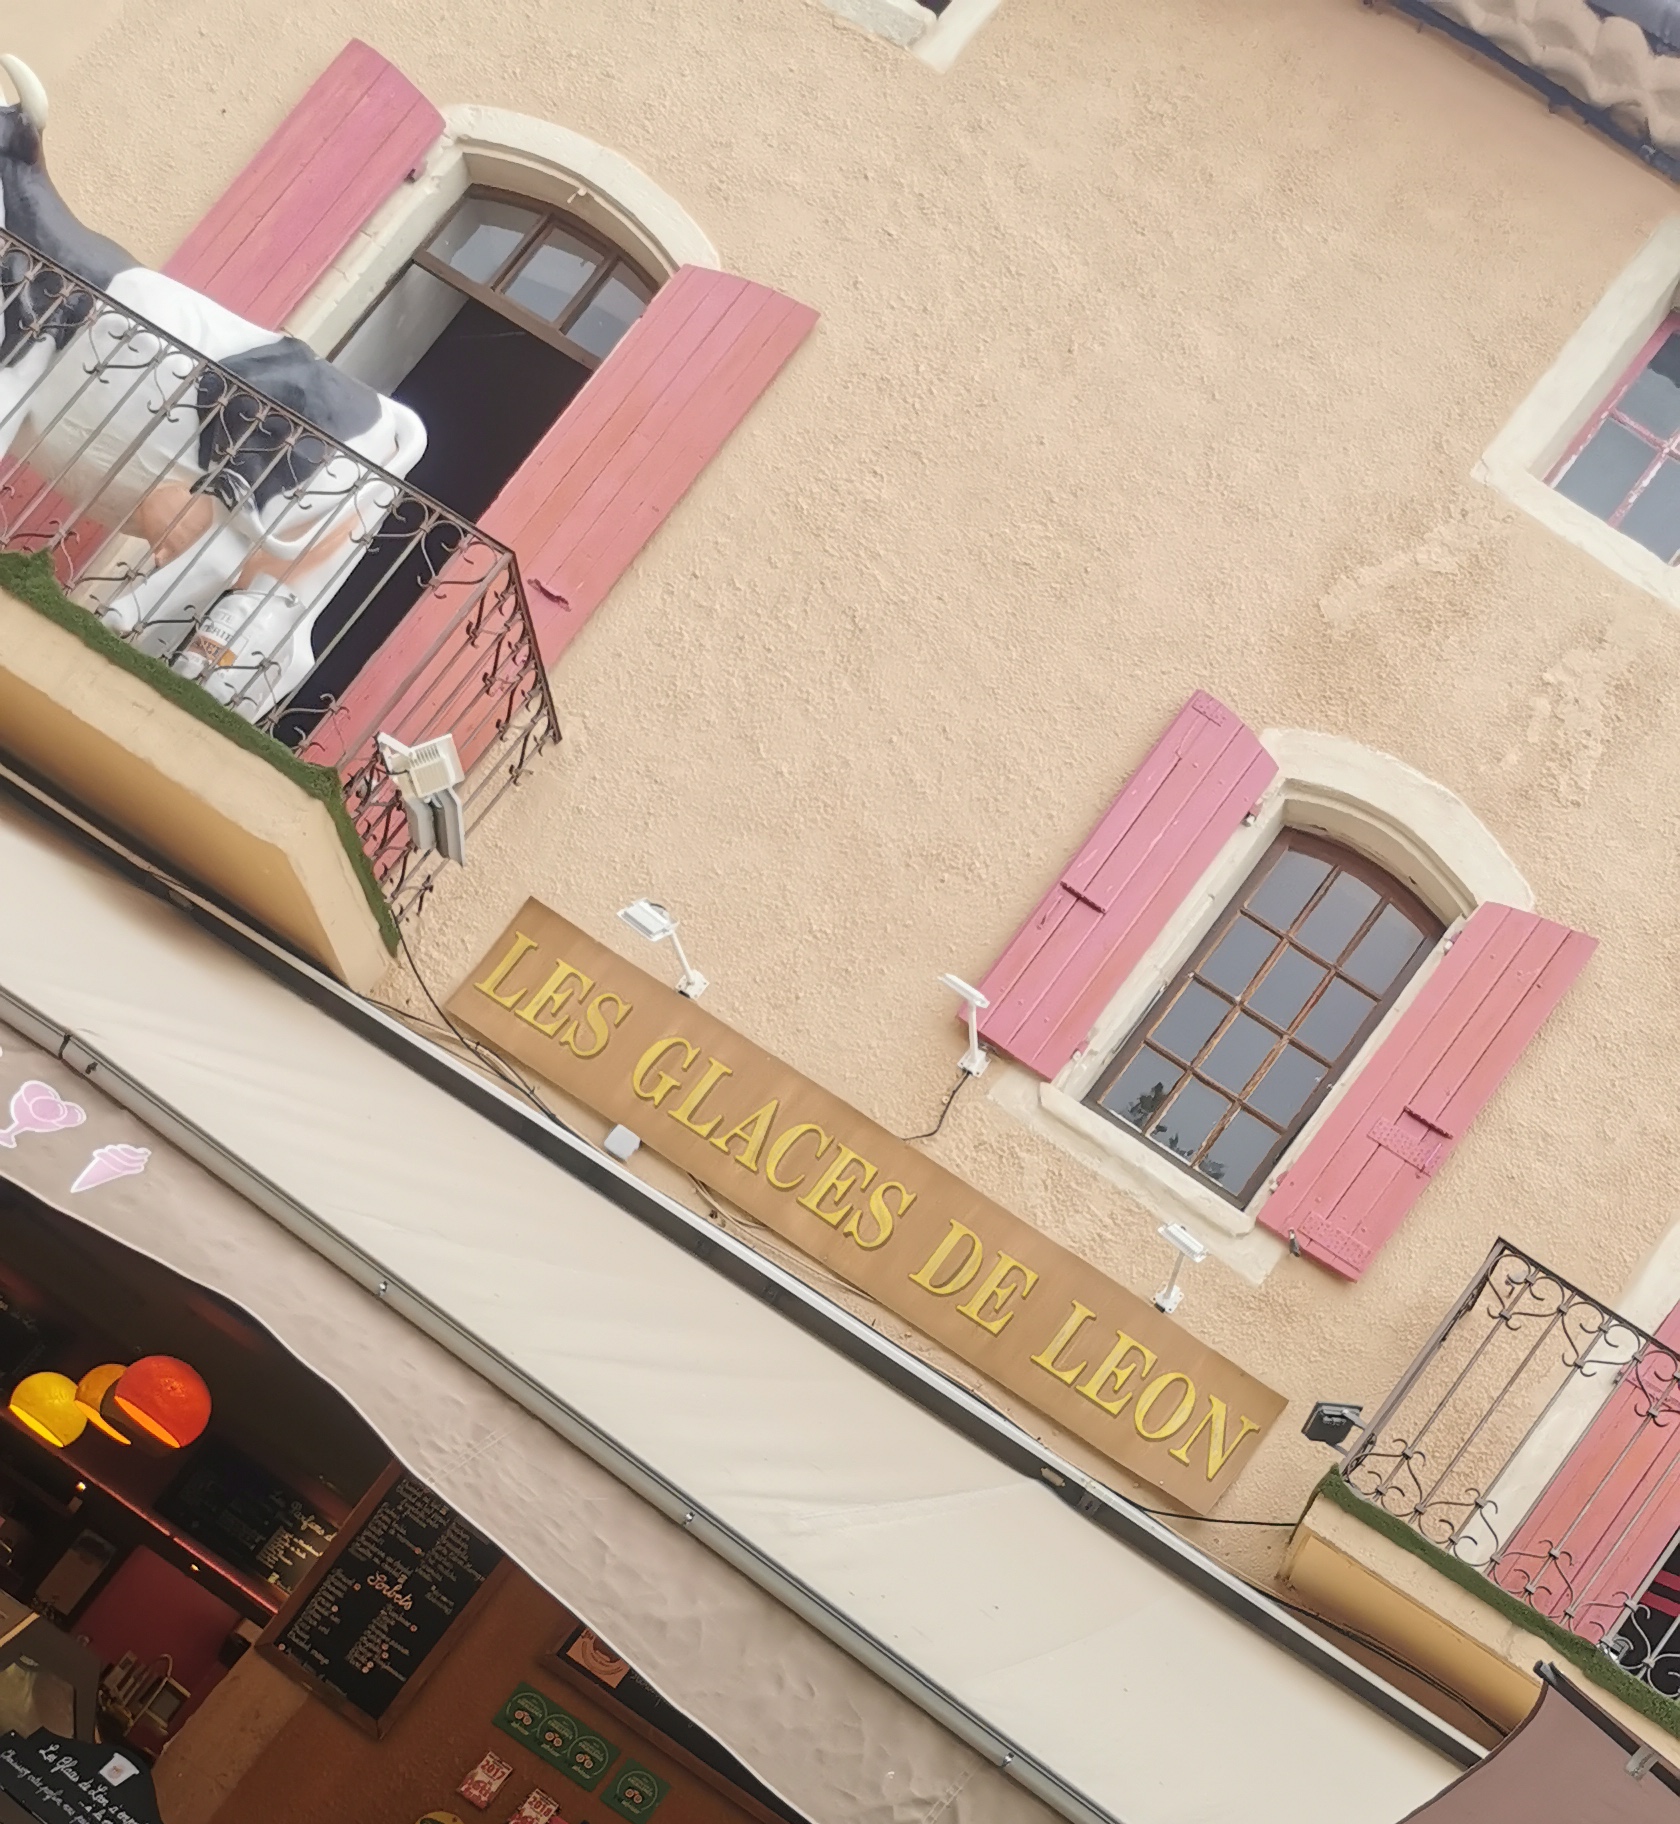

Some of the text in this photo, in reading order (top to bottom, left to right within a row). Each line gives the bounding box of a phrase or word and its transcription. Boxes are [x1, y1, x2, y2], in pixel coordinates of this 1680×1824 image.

[474, 931, 1261, 1479] LES GLACES DE LEON
[366, 1572, 412, 1610] Sorbets
[39, 1744, 59, 1762] Les
[79, 1778, 93, 1790] de
[480, 1760, 506, 1781] 2017
[527, 1795, 552, 1817] 2018
